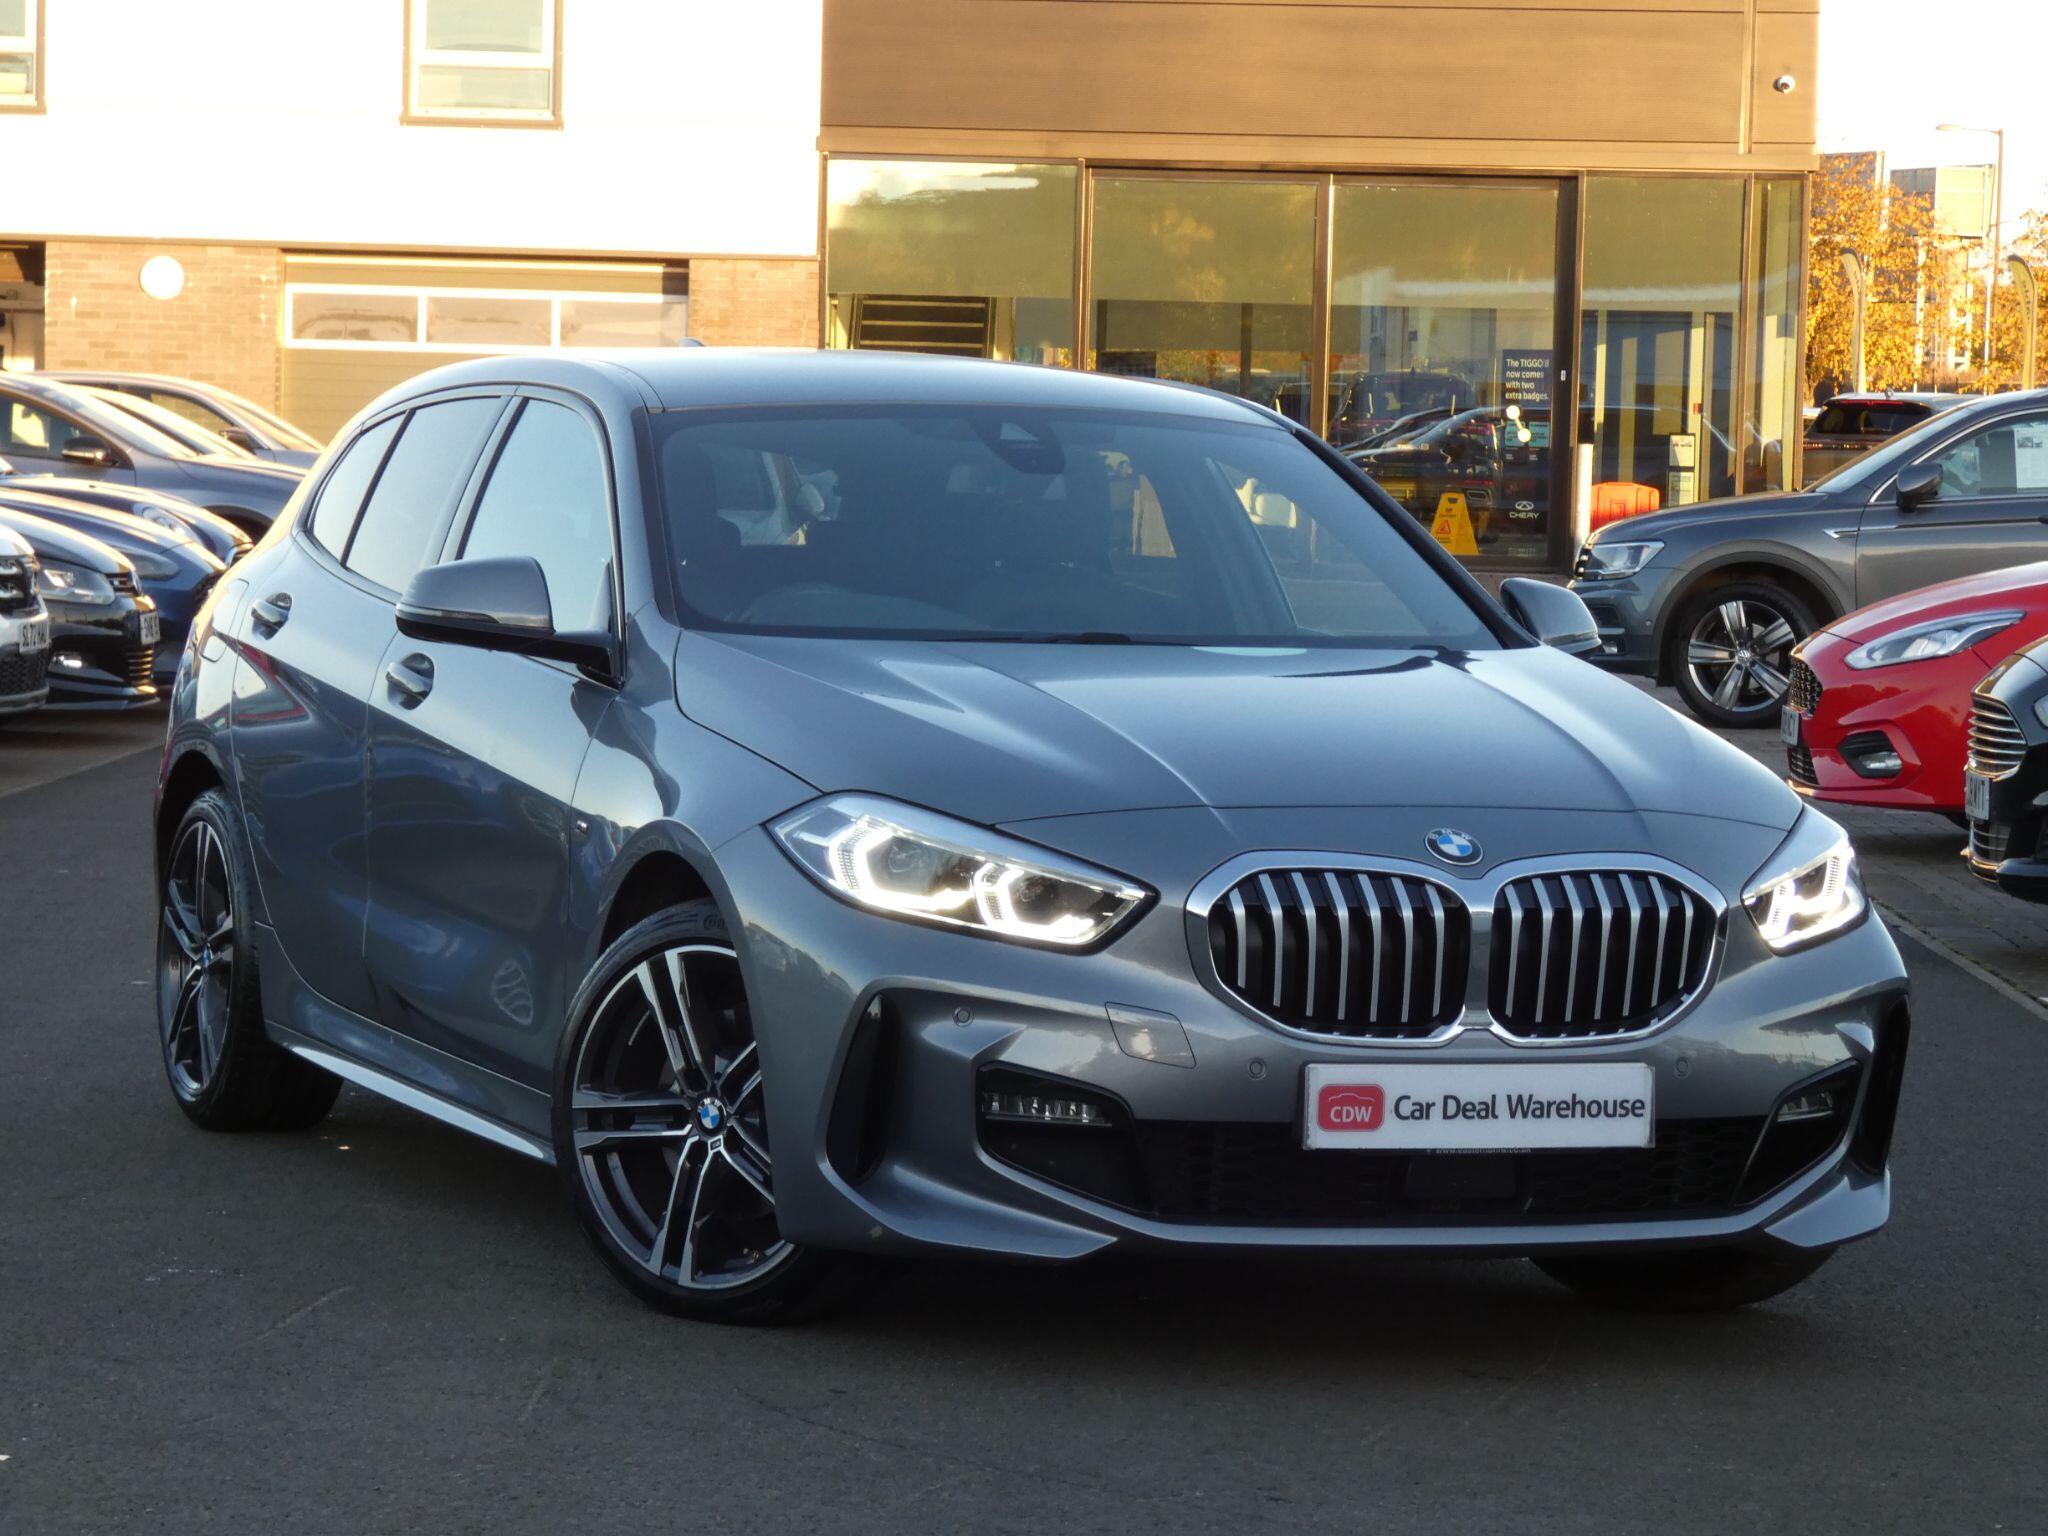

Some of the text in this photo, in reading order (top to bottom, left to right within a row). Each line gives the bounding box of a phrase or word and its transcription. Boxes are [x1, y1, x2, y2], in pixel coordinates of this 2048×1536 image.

[1505, 358, 1519, 368] The
[1520, 358, 1543, 368] TIGGO
[1505, 371, 1545, 379] now comes
[1505, 380, 1535, 389] with two
[1505, 391, 1549, 402] extra badges.
[1394, 1093, 1646, 1121] Car Deal Warehouse
[1330, 1106, 1373, 1123] CDW
